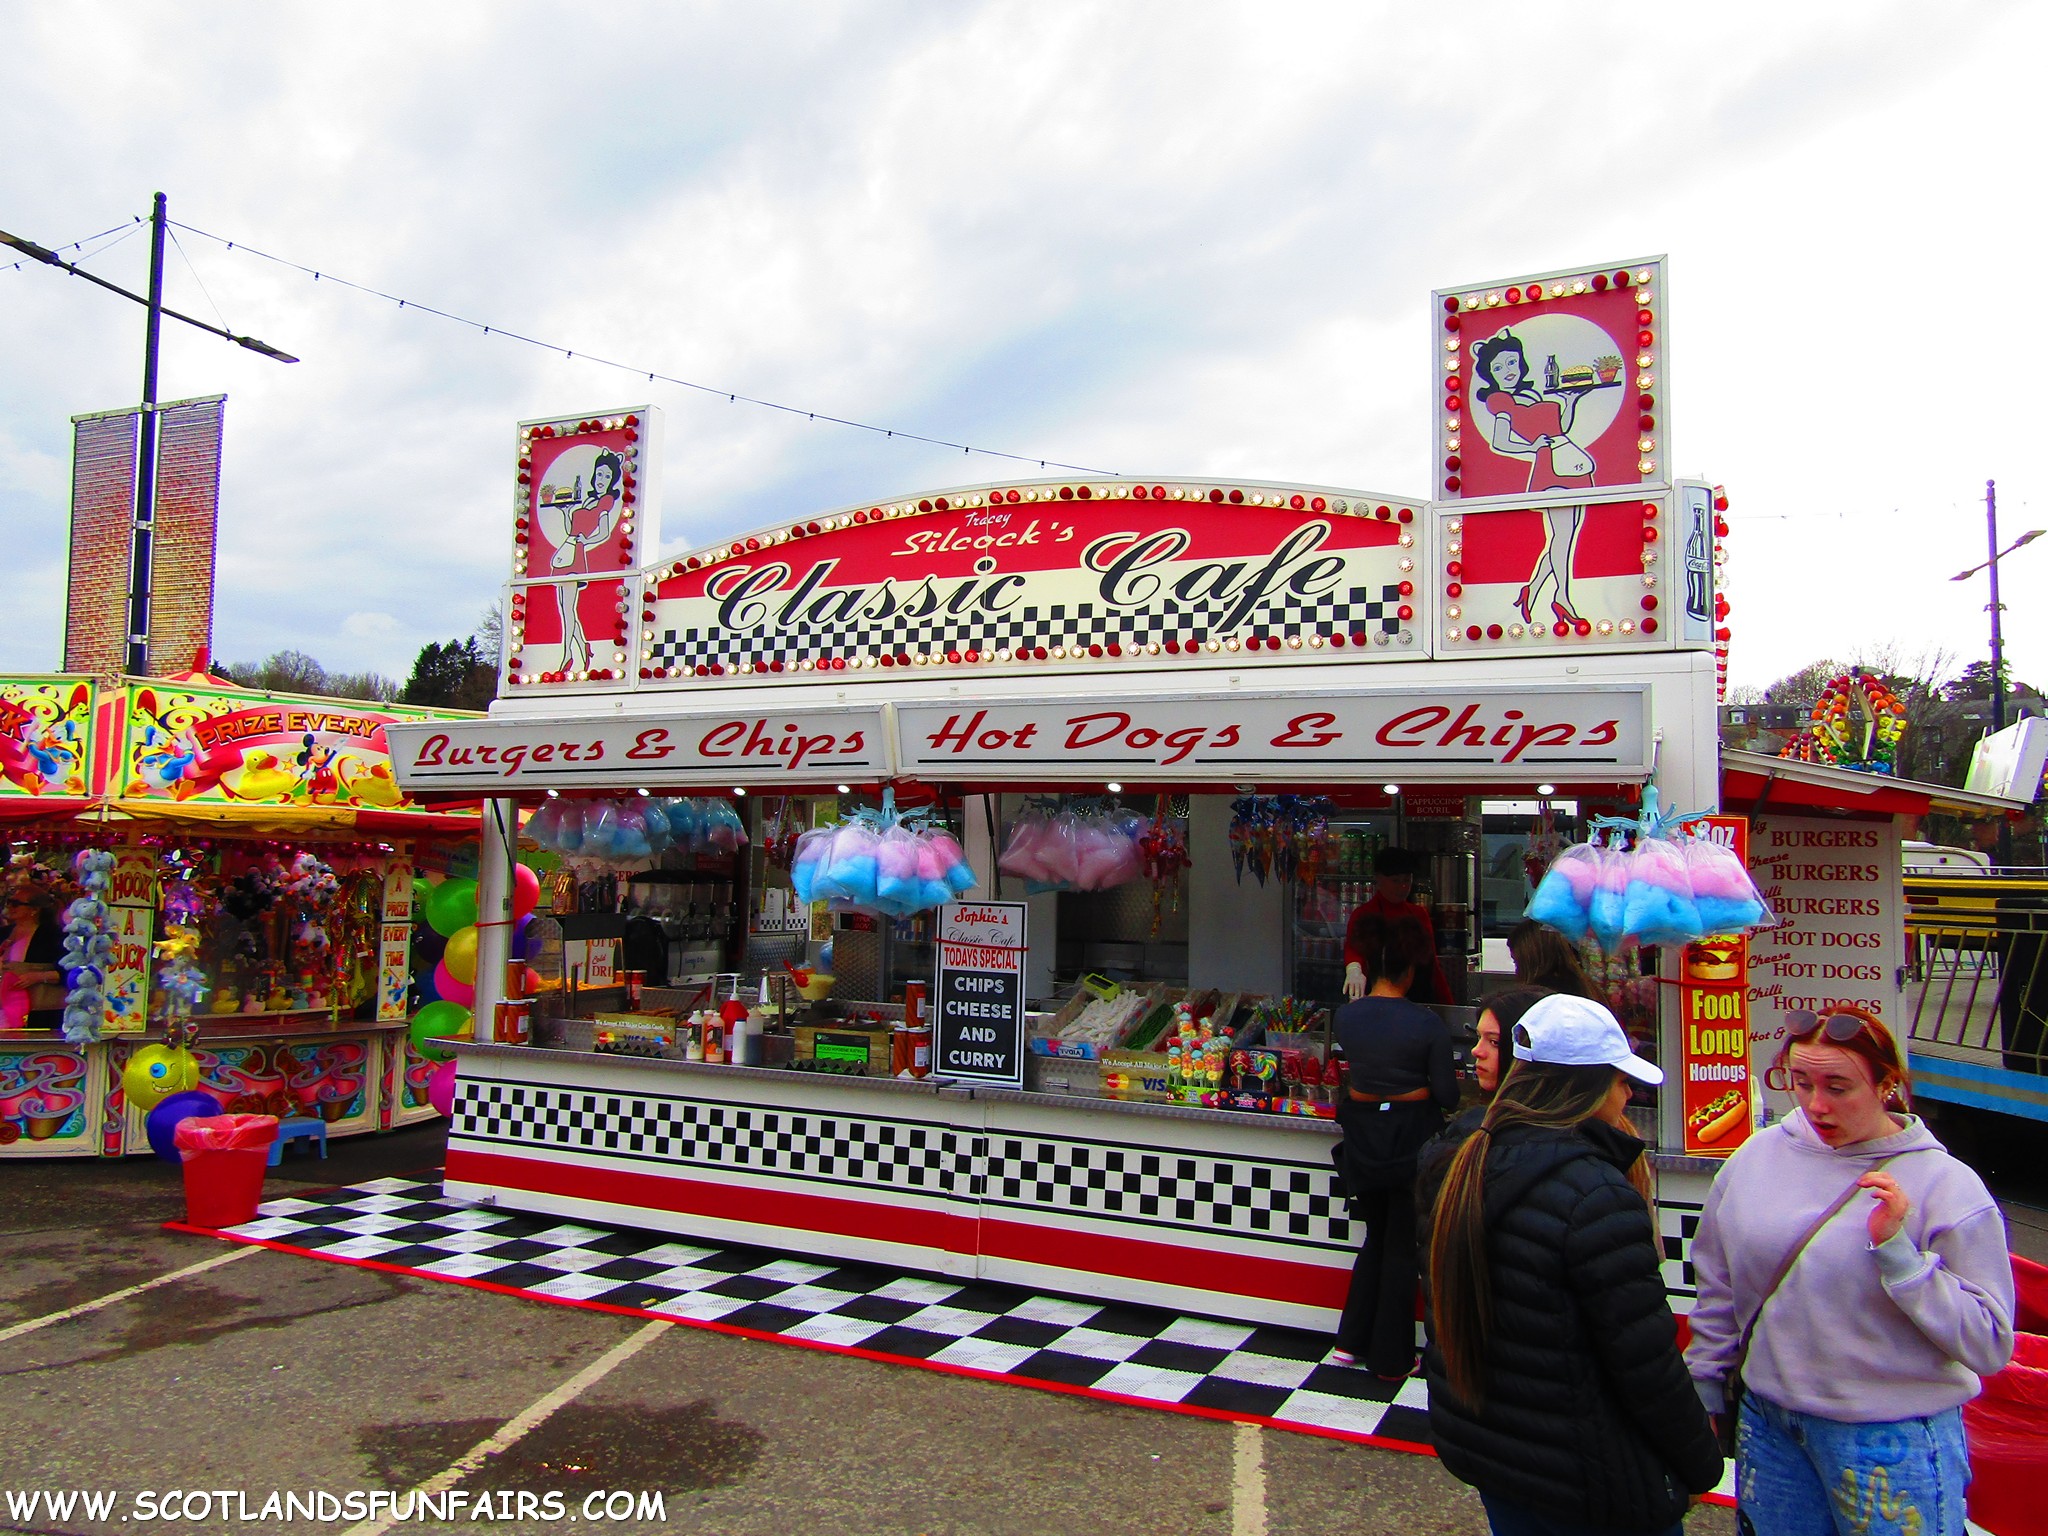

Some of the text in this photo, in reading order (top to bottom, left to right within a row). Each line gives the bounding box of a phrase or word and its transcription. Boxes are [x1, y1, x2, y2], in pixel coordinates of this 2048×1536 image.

[965, 510, 1012, 528] Tracey
[890, 519, 1075, 556] Silcock's
[703, 518, 1347, 637] Classic Cafe
[195, 713, 280, 752] PRIZE
[288, 711, 379, 739] EVERY
[926, 706, 1621, 766] Hot Dogs & Chips
[413, 733, 605, 777] Burgers
[625, 728, 676, 760] &
[697, 718, 866, 770] Chips
[1416, 806, 1451, 814] BOVRIL
[1770, 830, 1879, 848] BURGERS
[1748, 853, 1789, 870] Cheese
[1771, 864, 1880, 881] BURGERS
[111, 871, 153, 903] HOOK
[386, 901, 409, 917] PRIZE
[954, 906, 1008, 926] Sophie's
[1773, 897, 1880, 916] BURGERS
[123, 909, 135, 936] A
[383, 926, 409, 942] EVERY
[946, 926, 1016, 948] Classic Cafe
[1773, 931, 1881, 948] HOT DOGS
[944, 947, 1018, 970] TODAYS SPECIAL
[1747, 952, 1791, 969] Cheese
[1773, 962, 1882, 980] HOT DOGS
[954, 976, 1005, 995] CHIPS
[1747, 984, 1783, 1002] Chilli
[946, 1000, 1012, 1020] CHEESE
[1692, 989, 1742, 1021] Foot
[1773, 996, 1817, 1011] HOT
[959, 1026, 997, 1043] AND
[1689, 1024, 1744, 1059] Long
[1749, 1032, 1770, 1043] Hot
[949, 1050, 1006, 1069] CURRY
[1101, 1058, 1112, 1066] We
[1112, 1060, 1133, 1068] Accept
[1689, 1062, 1747, 1083] Hotdogs
[1143, 1077, 1168, 1091] VIS
